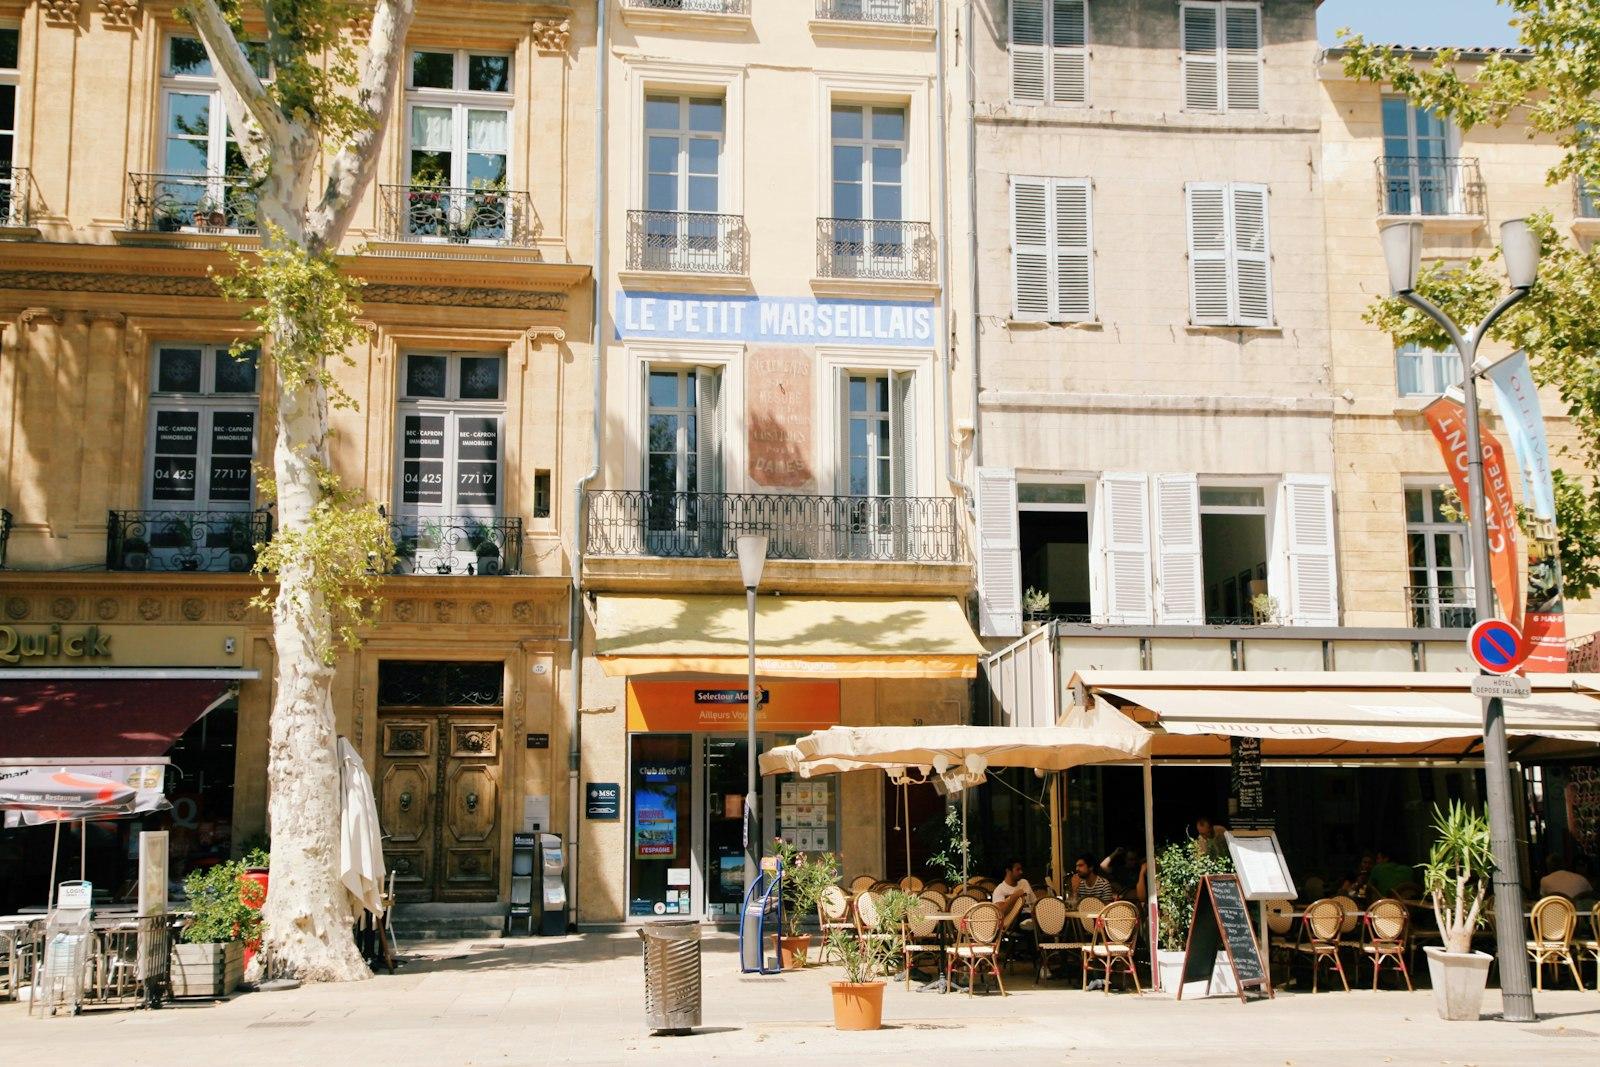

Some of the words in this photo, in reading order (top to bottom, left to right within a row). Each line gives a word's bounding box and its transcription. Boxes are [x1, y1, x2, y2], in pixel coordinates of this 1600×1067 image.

[624, 298, 656, 332] LE
[668, 302, 746, 334] PETIT
[760, 302, 930, 340] MARSEILLAIS
[155, 470, 170, 479] 04
[173, 470, 194, 480] 425
[404, 474, 418, 483] 04
[421, 474, 441, 483] 425
[1488, 463, 1517, 542] CENTRE
[0, 624, 112, 662] Quick
[700, 711, 730, 719] Ailleurs
